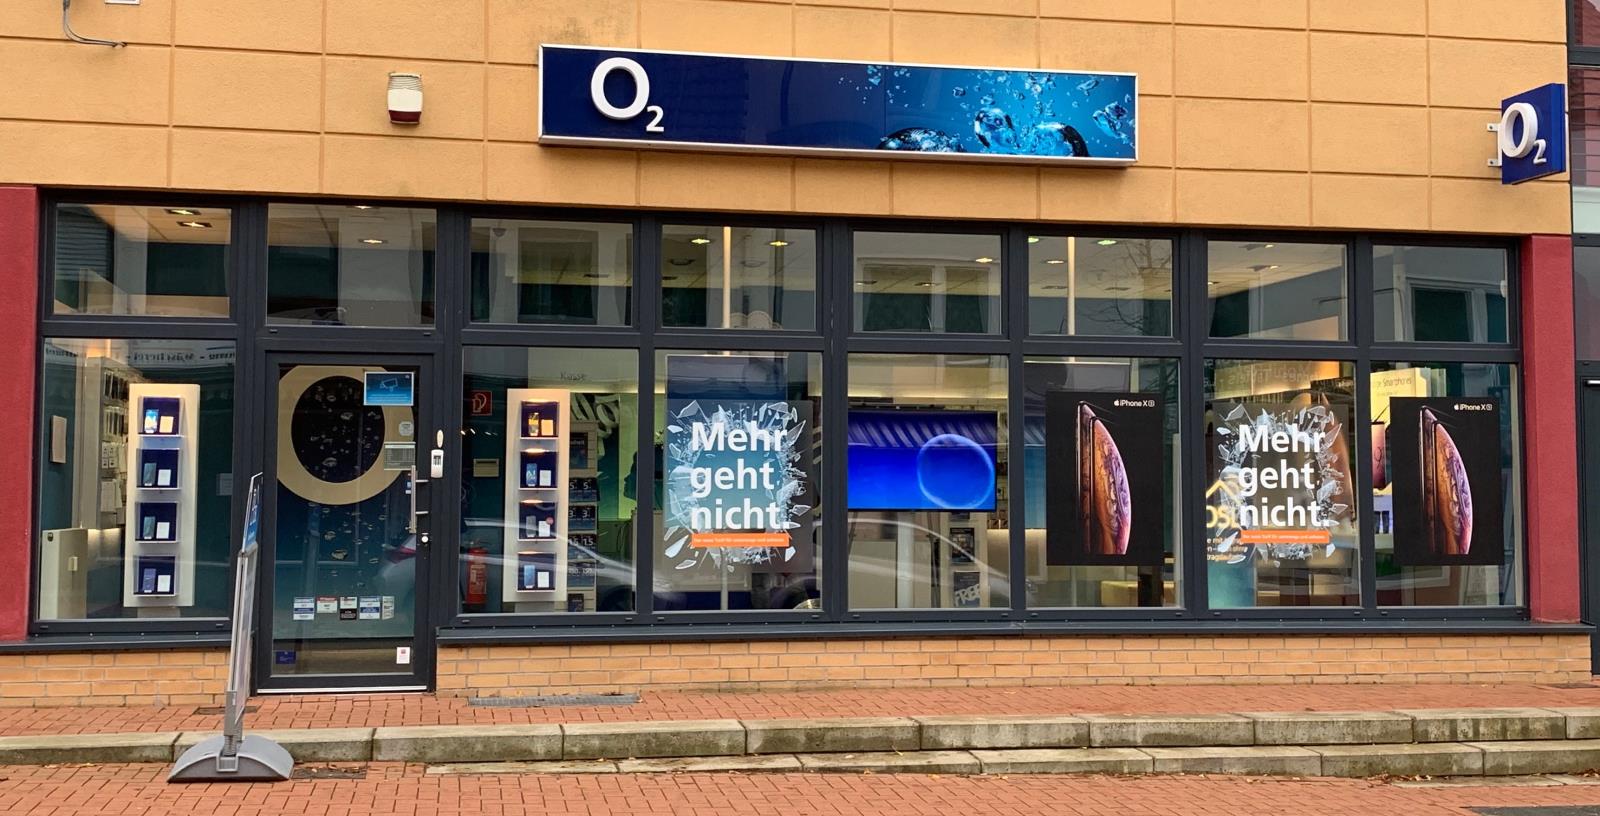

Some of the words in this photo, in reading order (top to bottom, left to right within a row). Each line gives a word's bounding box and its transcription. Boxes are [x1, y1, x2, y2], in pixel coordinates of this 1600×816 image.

[1119, 399, 1142, 407] iPhone
[1459, 403, 1481, 411] iPhone
[691, 420, 788, 452] Mehr
[1238, 423, 1326, 453] Mehr
[690, 458, 775, 498] geht
[1238, 459, 1315, 497] geht
[691, 498, 791, 530] nicht.
[1238, 496, 1331, 528] nicht.
